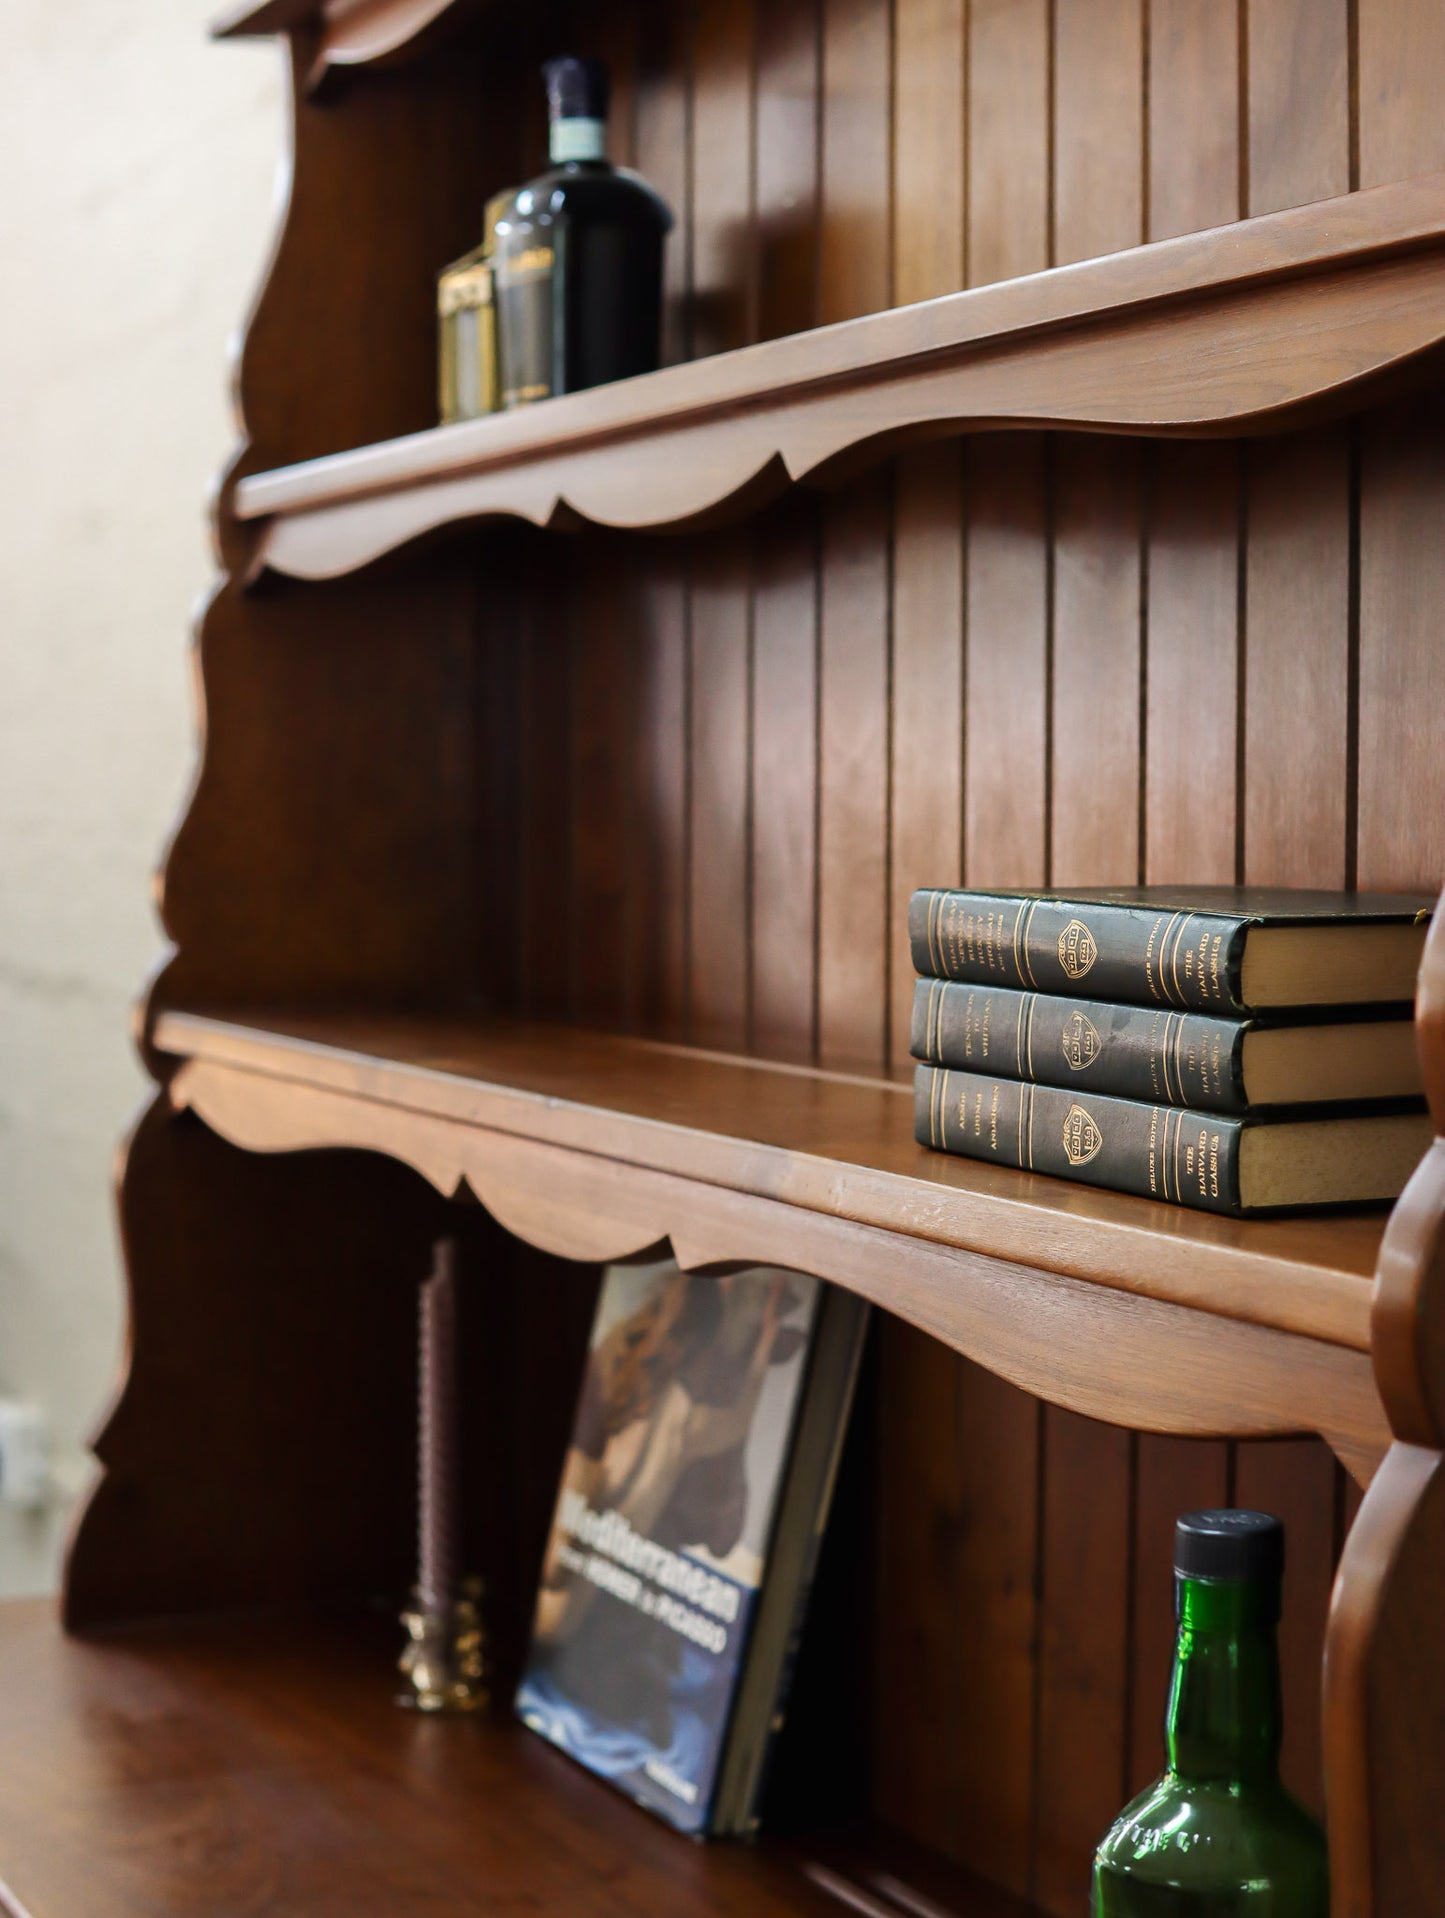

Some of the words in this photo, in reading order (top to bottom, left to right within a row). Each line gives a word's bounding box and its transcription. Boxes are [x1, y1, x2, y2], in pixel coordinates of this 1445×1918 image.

[957, 909, 967, 964] NEWMAN
[976, 914, 986, 965] HUXLEY
[986, 911, 996, 969] THOREAU
[1145, 917, 1163, 958] EDITION
[1184, 949, 1194, 979] THE
[1197, 932, 1210, 997] HARVARD
[1209, 935, 1223, 999] CLASSICS
[981, 998, 992, 1057] WHITMAN
[958, 1091, 966, 1130] AESOP
[974, 1092, 983, 1136] GRIMM
[1149, 1106, 1159, 1149] EDITION
[1148, 1151, 1158, 1192] DELUXE
[1185, 1145, 1194, 1175] THE
[1197, 1129, 1208, 1196] HARVARD
[1208, 1134, 1220, 1198] CLASSICS
